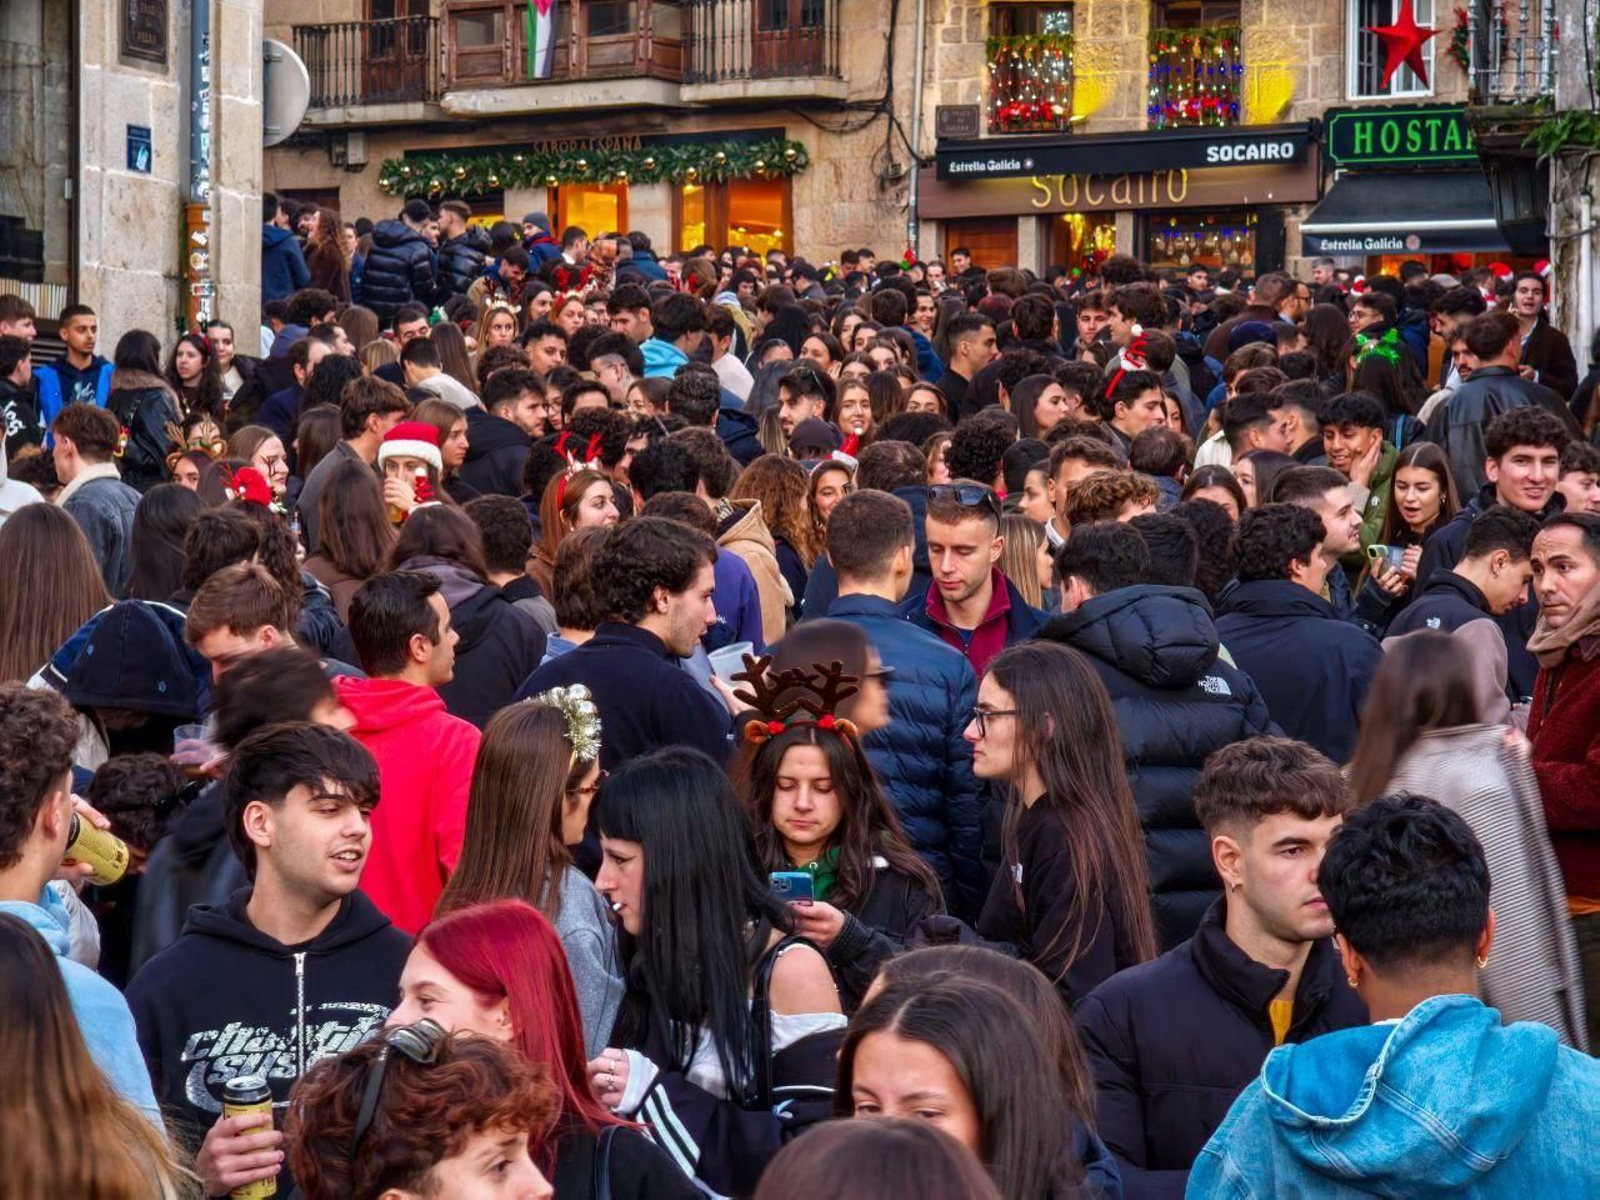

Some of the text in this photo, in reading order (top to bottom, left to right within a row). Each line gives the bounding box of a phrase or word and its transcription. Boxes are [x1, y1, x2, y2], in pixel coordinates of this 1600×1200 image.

[1206, 141, 1294, 162] SOCAIRO
[949, 158, 1021, 173] Estrella Galicia
[1320, 236, 1403, 251] Estrella Galicia
